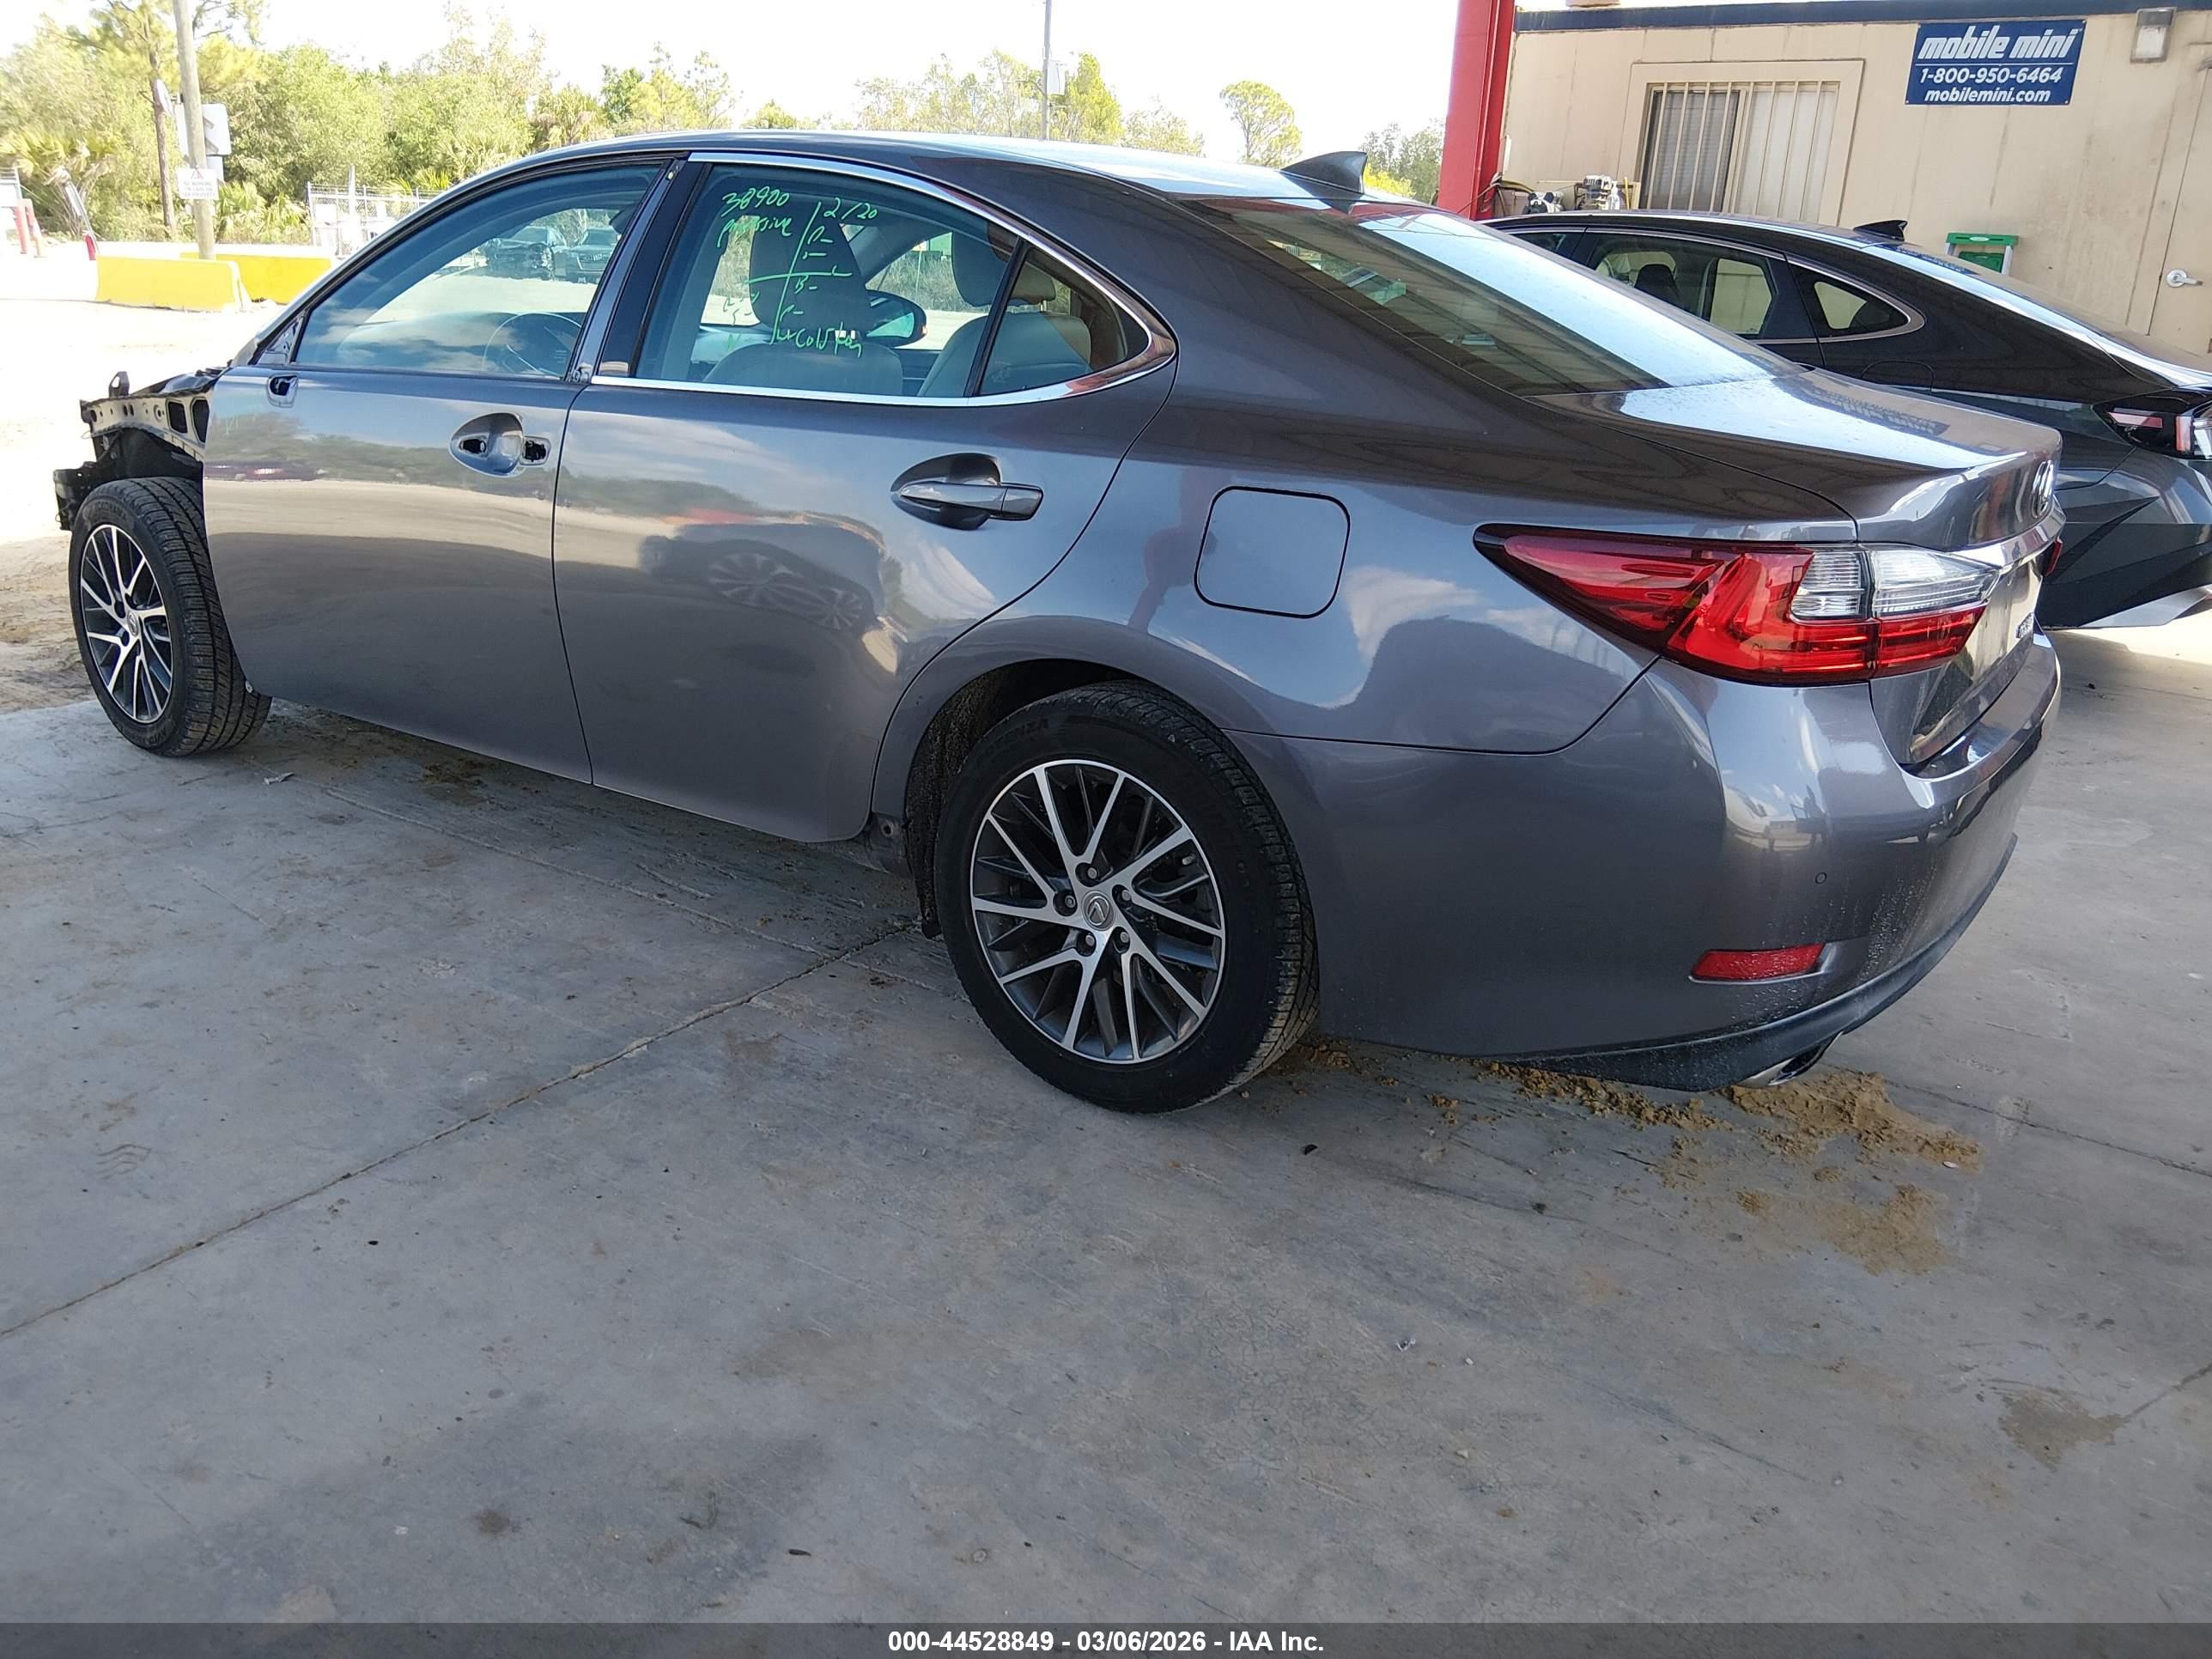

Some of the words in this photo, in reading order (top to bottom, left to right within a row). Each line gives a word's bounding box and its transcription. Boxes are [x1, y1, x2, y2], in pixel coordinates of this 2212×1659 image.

[1917, 25, 2010, 60] mobile
[2008, 28, 2079, 59] mini
[1920, 67, 2064, 84] 1-800-950-6464
[1924, 87, 2051, 103] mobilemini.com
